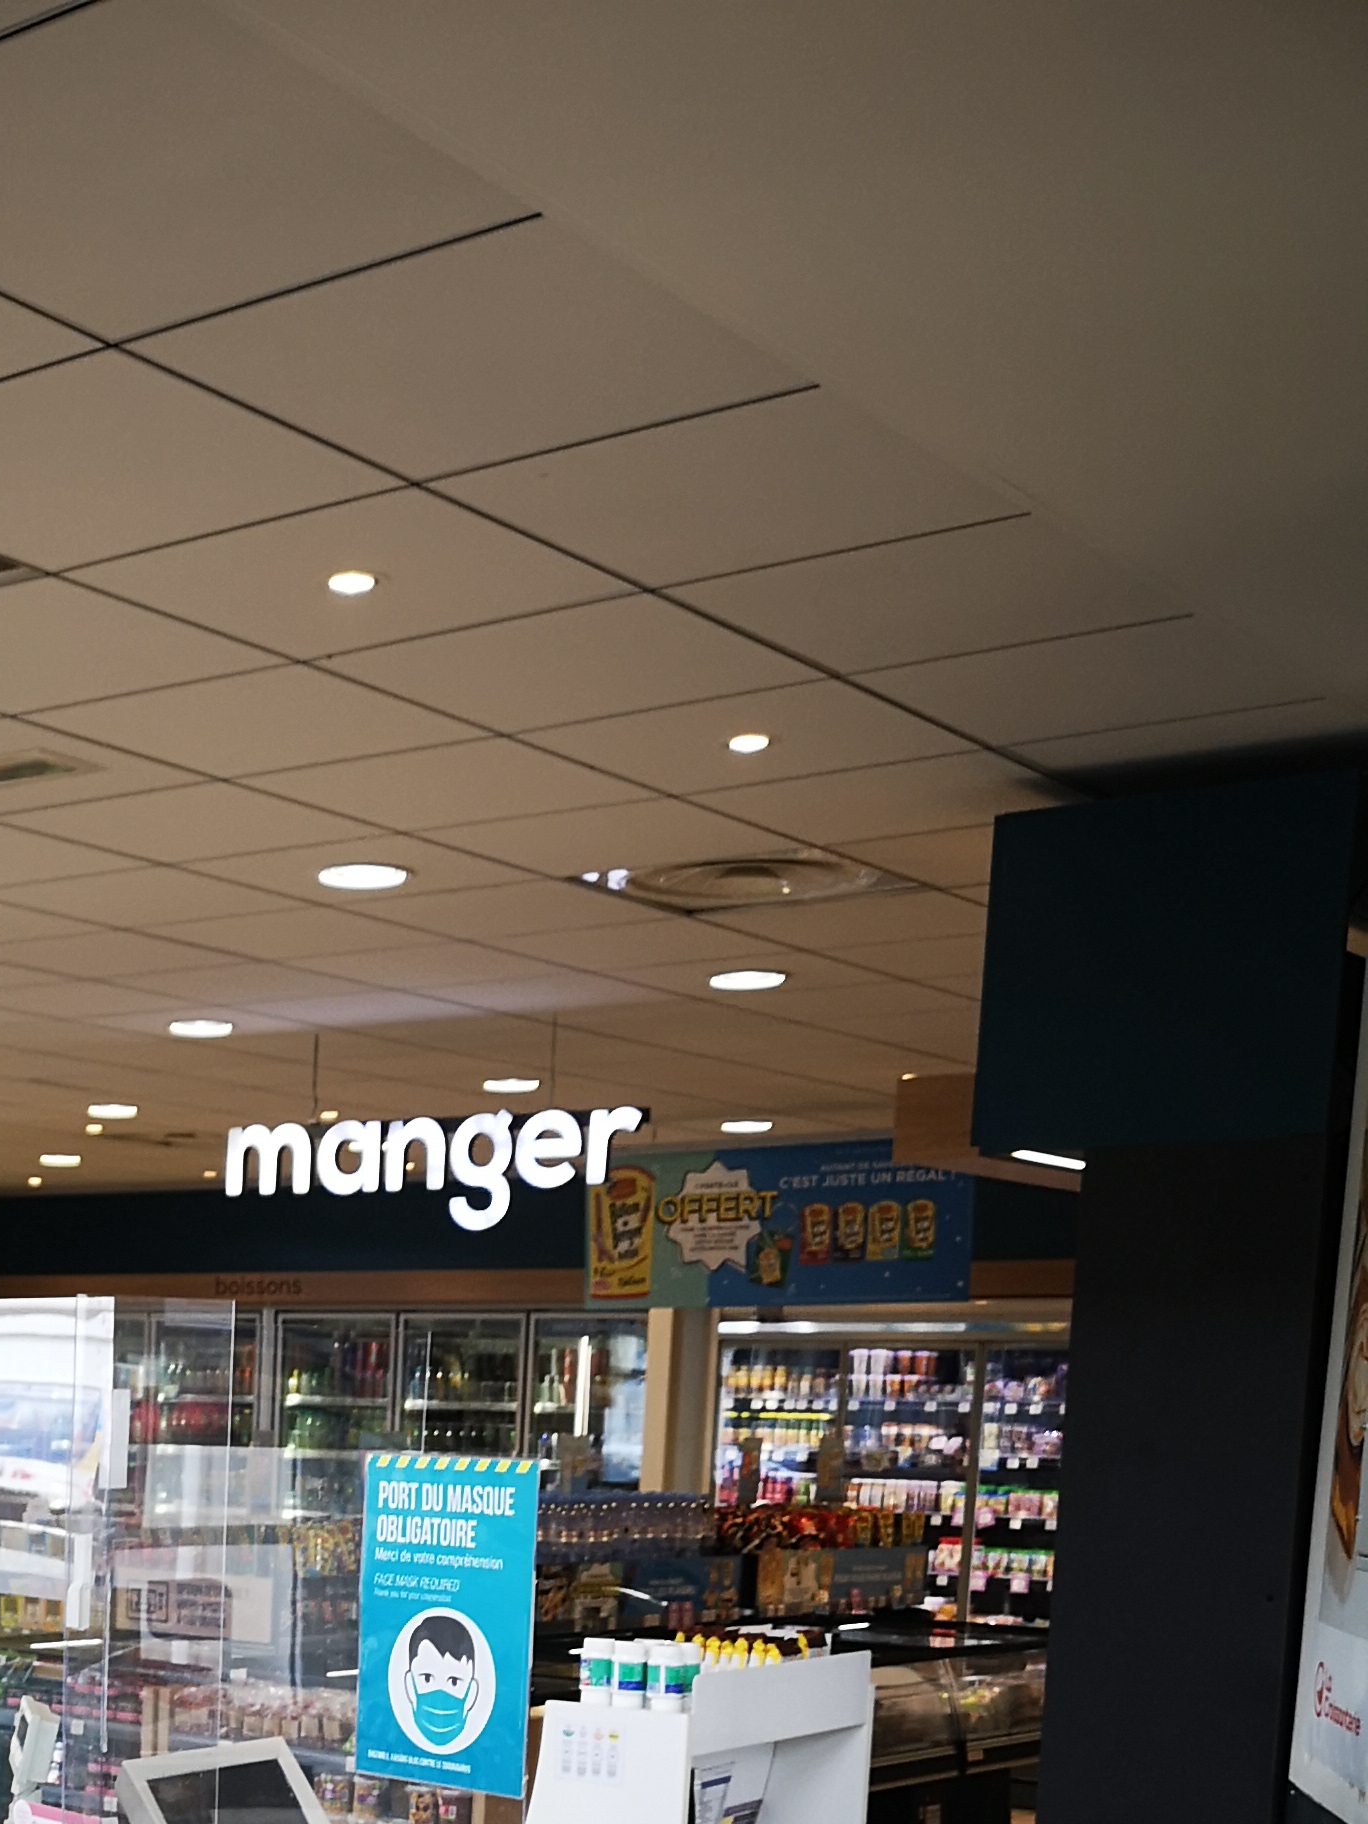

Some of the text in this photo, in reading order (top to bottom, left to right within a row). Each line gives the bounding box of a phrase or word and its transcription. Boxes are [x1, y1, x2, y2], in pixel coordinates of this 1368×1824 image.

[224, 1105, 643, 1232] manger
[821, 1172, 867, 1187] JUSTE
[870, 1171, 892, 1184] UN
[656, 1190, 778, 1222] OFFERT
[215, 1275, 302, 1297] boissons
[377, 1480, 516, 1517] PORT DU MASQUE
[375, 1514, 478, 1549] OBLIGATOIRE
[374, 1547, 504, 1571] Merci de votre compréhension
[373, 1572, 461, 1592] FACE MASK REQUIRED
